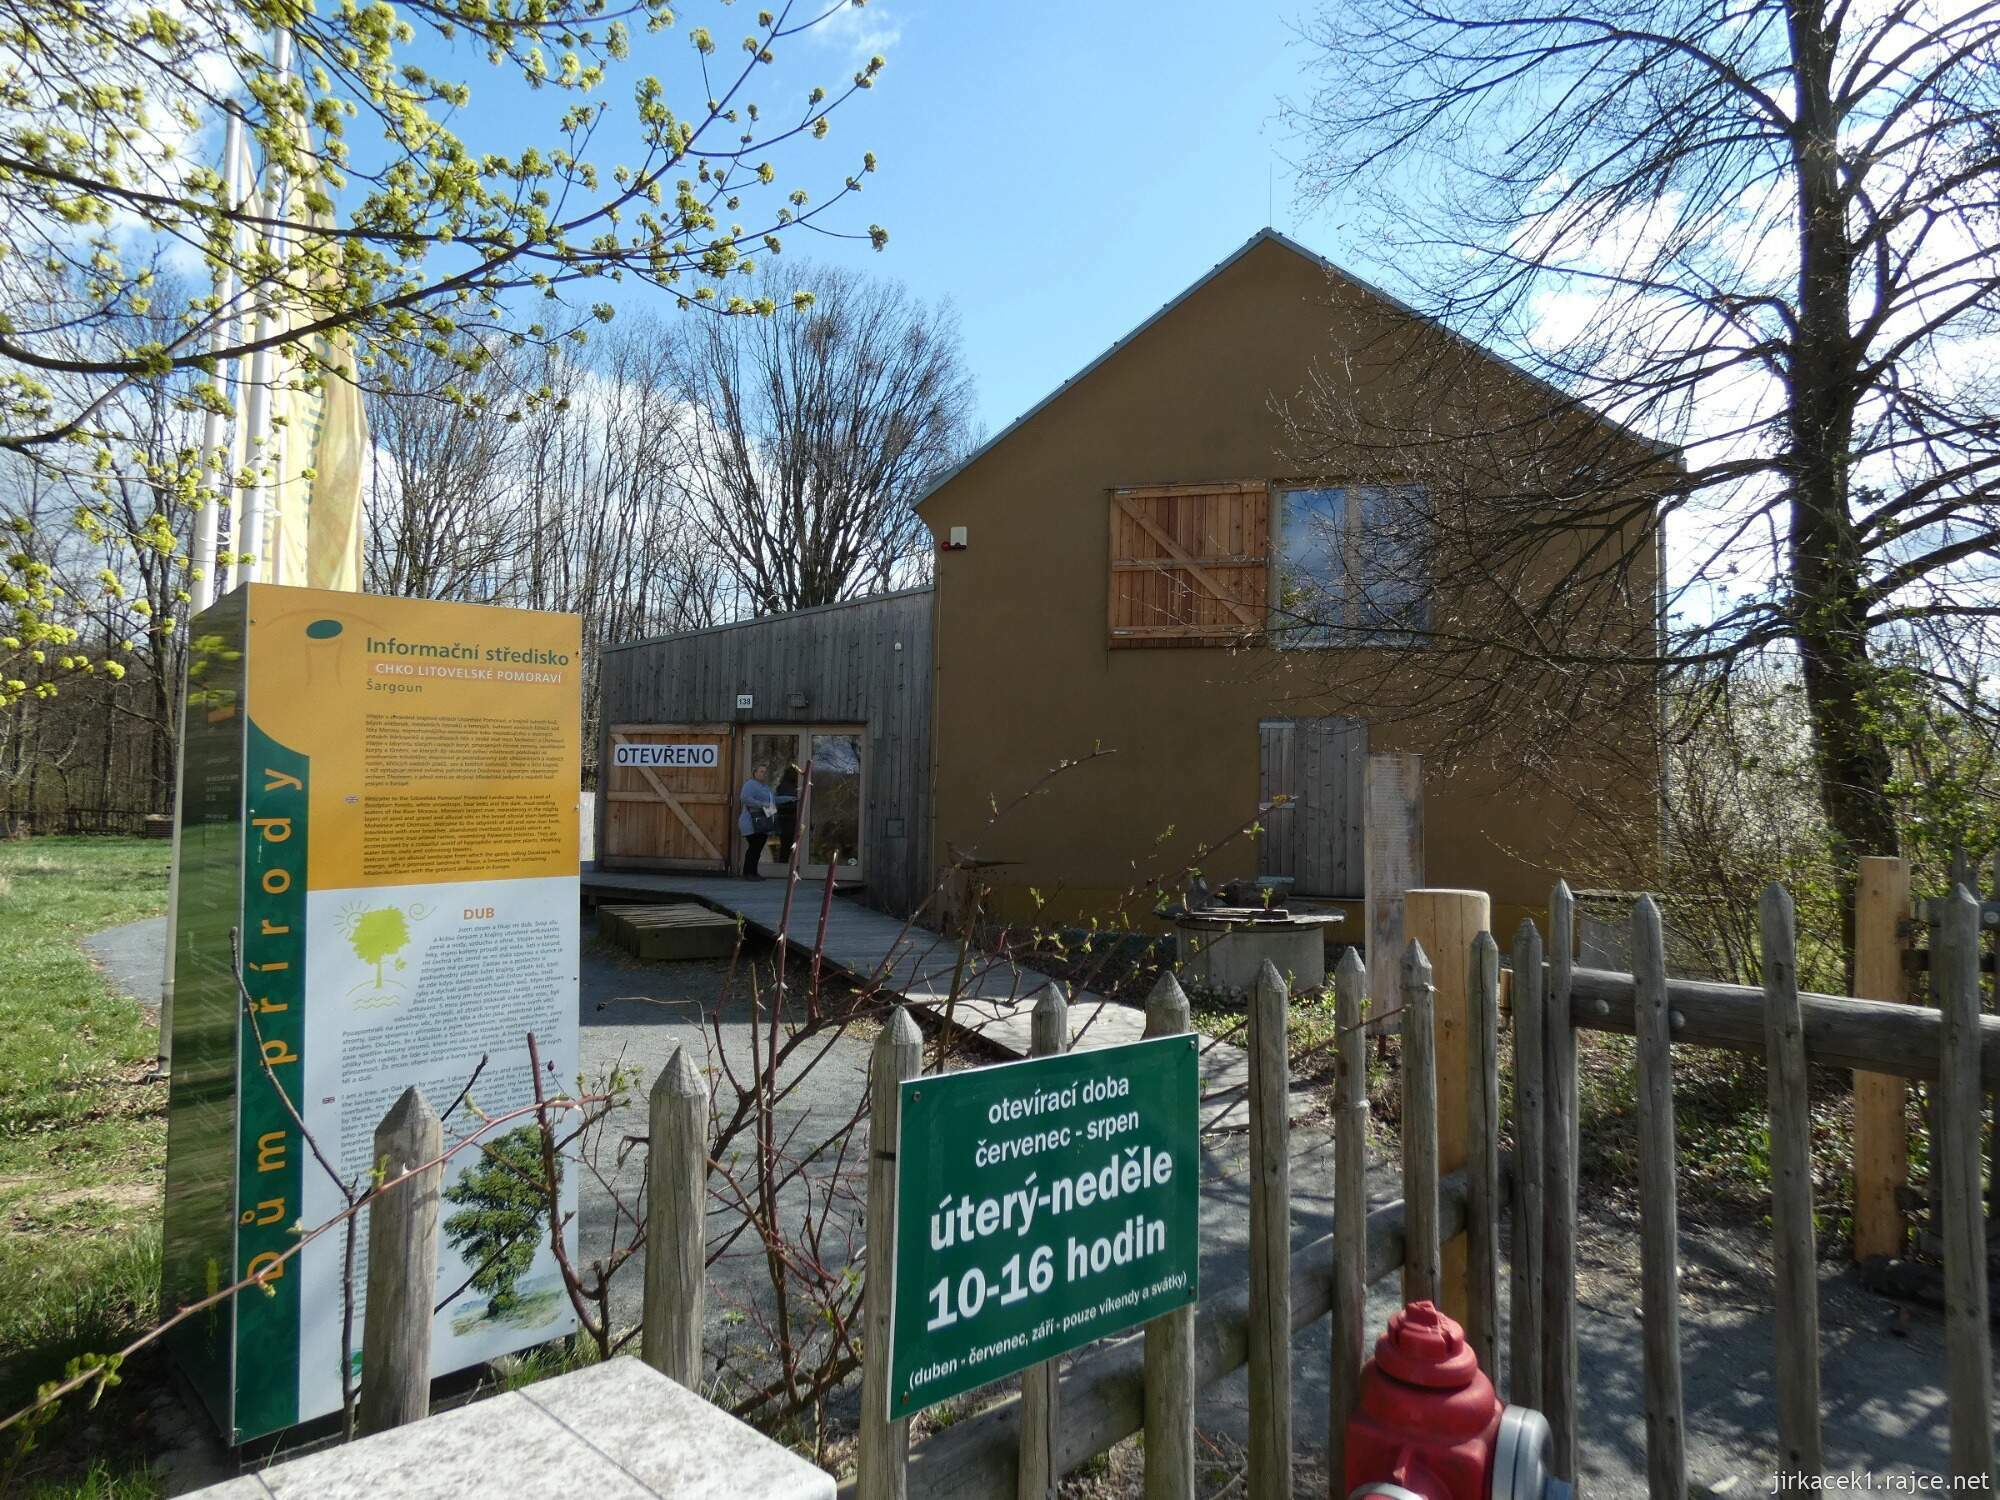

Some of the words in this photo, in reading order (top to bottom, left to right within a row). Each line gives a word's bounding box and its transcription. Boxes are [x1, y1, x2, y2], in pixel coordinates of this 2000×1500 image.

[367, 637, 479, 661] Informační
[485, 646, 569, 666] středisko
[376, 663, 413, 676] CHKO
[418, 666, 493, 680] LITOVELSKÉ
[497, 670, 562, 684] POMORAVÍ
[366, 679, 423, 694] Šargoun
[616, 744, 715, 764] OTEVŘENO
[246, 768, 303, 1067] přírody
[463, 907, 496, 921] DUB
[988, 1081, 1078, 1124] otevírací
[1082, 1076, 1129, 1103] doba
[975, 1127, 1071, 1168] červenec
[1087, 1109, 1139, 1141] srpen
[239, 1130, 287, 1284] Dům
[930, 1145, 1173, 1251] úterý-neděle
[926, 1245, 1054, 1332] 10-16
[1067, 1215, 1166, 1282] hodin
[908, 1358, 958, 1391] (duben
[968, 1333, 1030, 1365] červenec,
[1031, 1321, 1054, 1344] září
[1062, 1306, 1097, 1331] pouze
[1099, 1287, 1141, 1314] víkendy
[1142, 1287, 1150, 1298] a
[1151, 1271, 1188, 1298] svátky)
